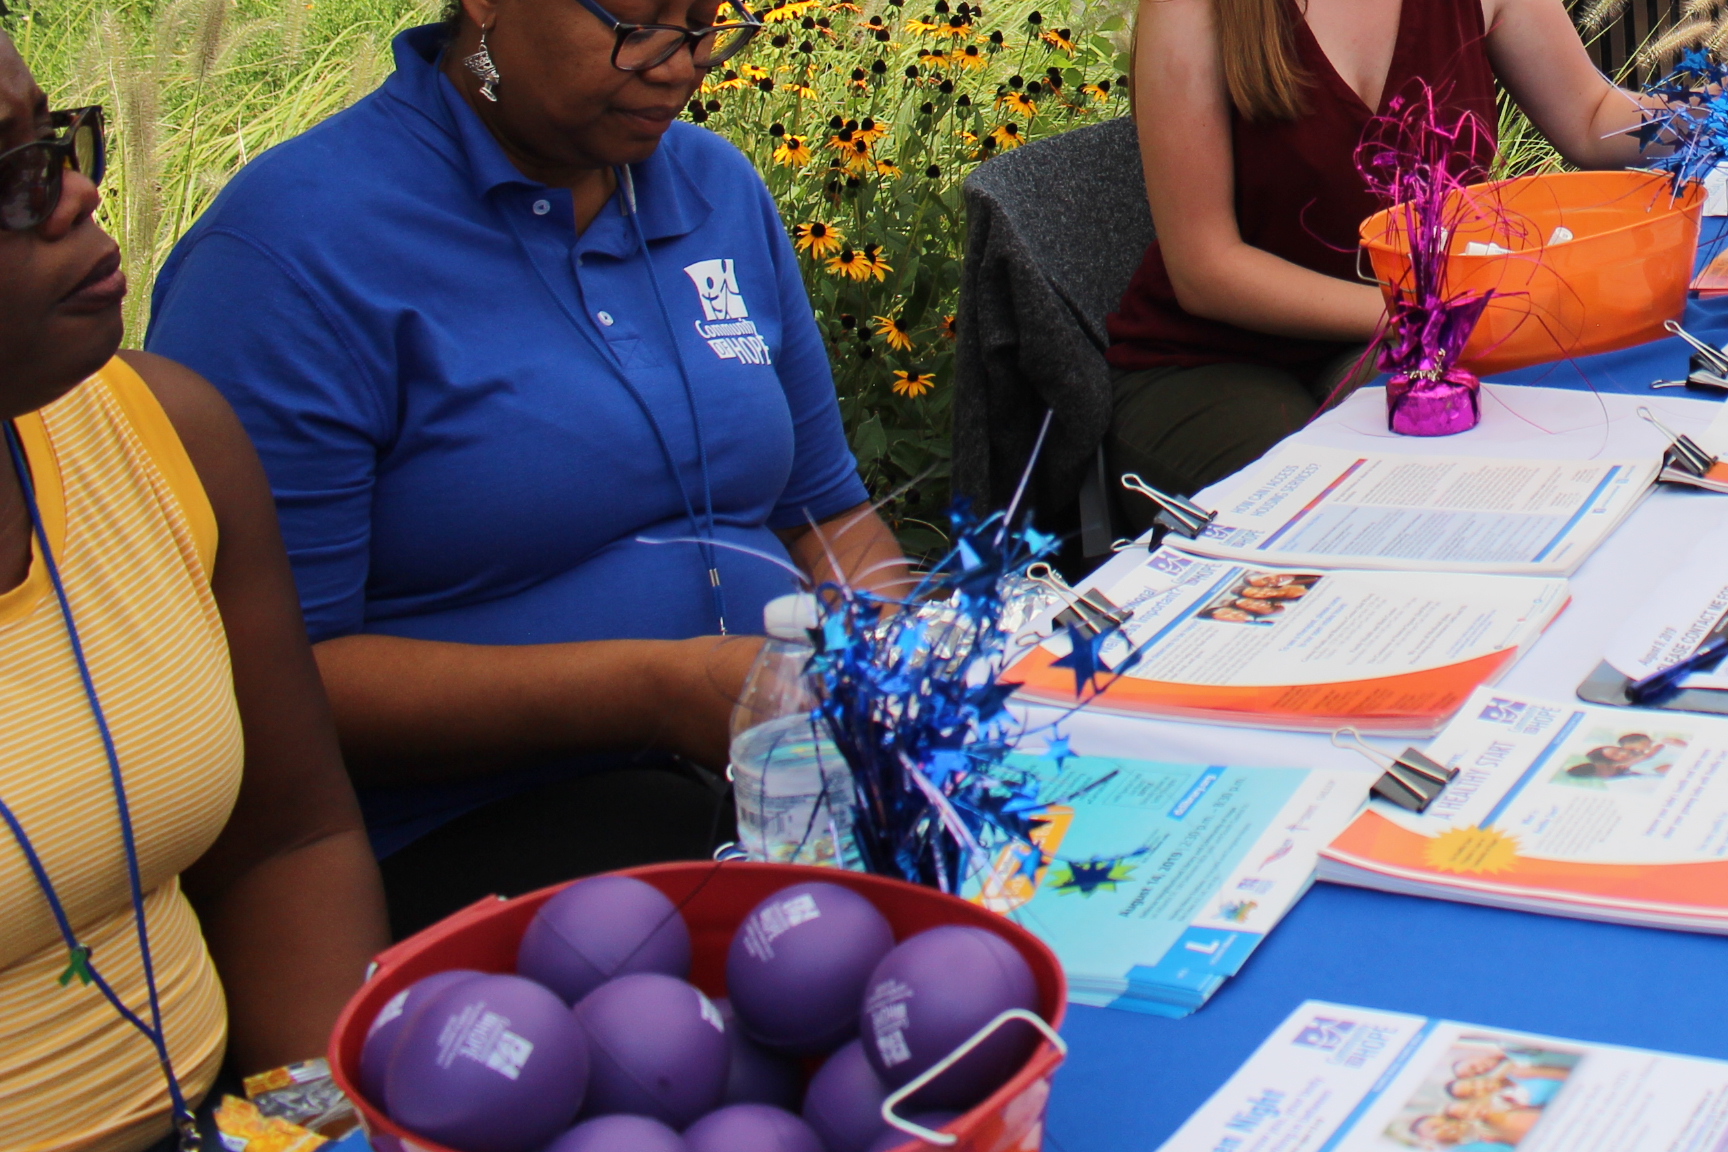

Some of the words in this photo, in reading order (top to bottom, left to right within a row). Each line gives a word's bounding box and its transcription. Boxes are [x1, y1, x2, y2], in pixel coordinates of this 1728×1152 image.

[695, 318, 759, 338] Community
[725, 335, 771, 365] HOPE
[1230, 500, 1256, 515] HOW
[1248, 489, 1271, 502] CAN
[1266, 465, 1299, 487] ACCESS
[1250, 492, 1289, 517] HOUSING
[1681, 610, 1718, 645] CONTACT
[1707, 599, 1728, 612] ME
[1437, 767, 1491, 811] HEALTHY
[1475, 740, 1516, 769] START
[1118, 886, 1151, 918] August
[1157, 851, 1183, 873] 2019
